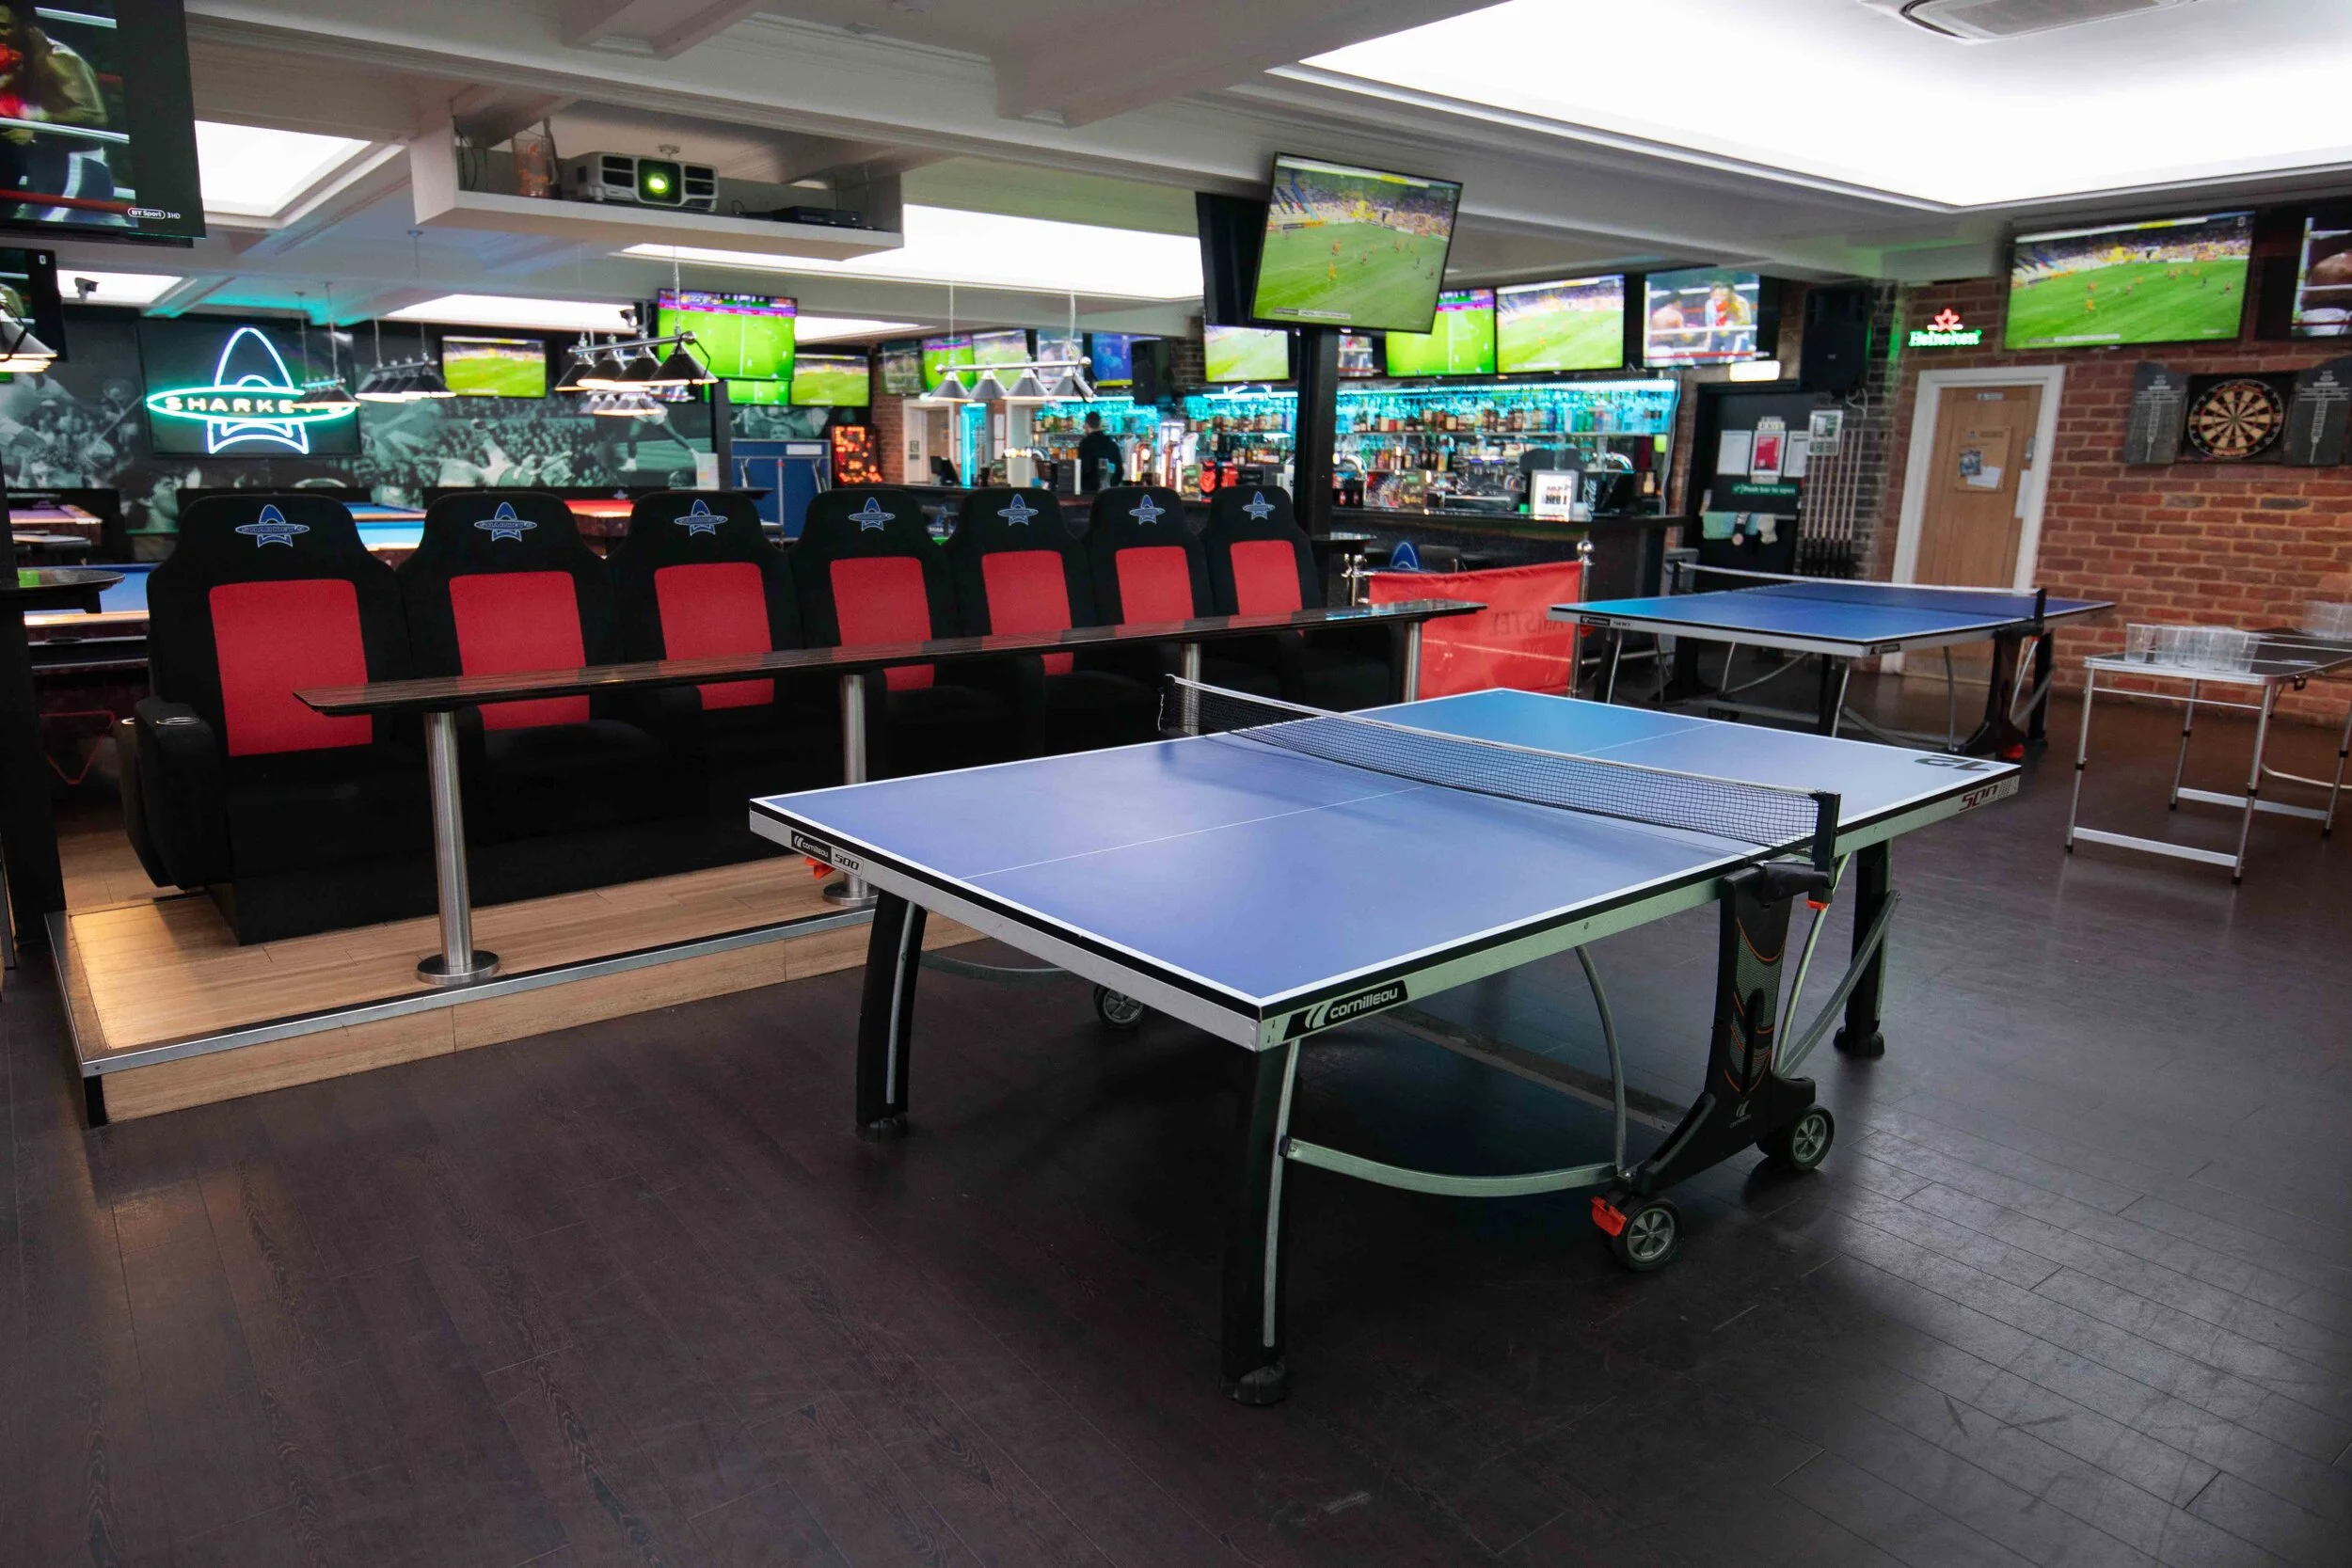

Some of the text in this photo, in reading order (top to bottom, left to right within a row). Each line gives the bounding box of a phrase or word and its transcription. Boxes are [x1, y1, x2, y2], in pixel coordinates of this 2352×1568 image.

[1908, 330, 1980, 347] Heineken
[164, 395, 342, 415] SHARKE
[1742, 484, 1758, 494] Push
[802, 842, 860, 871] cornilleau 500
[1329, 988, 1399, 1020] cornilleau
